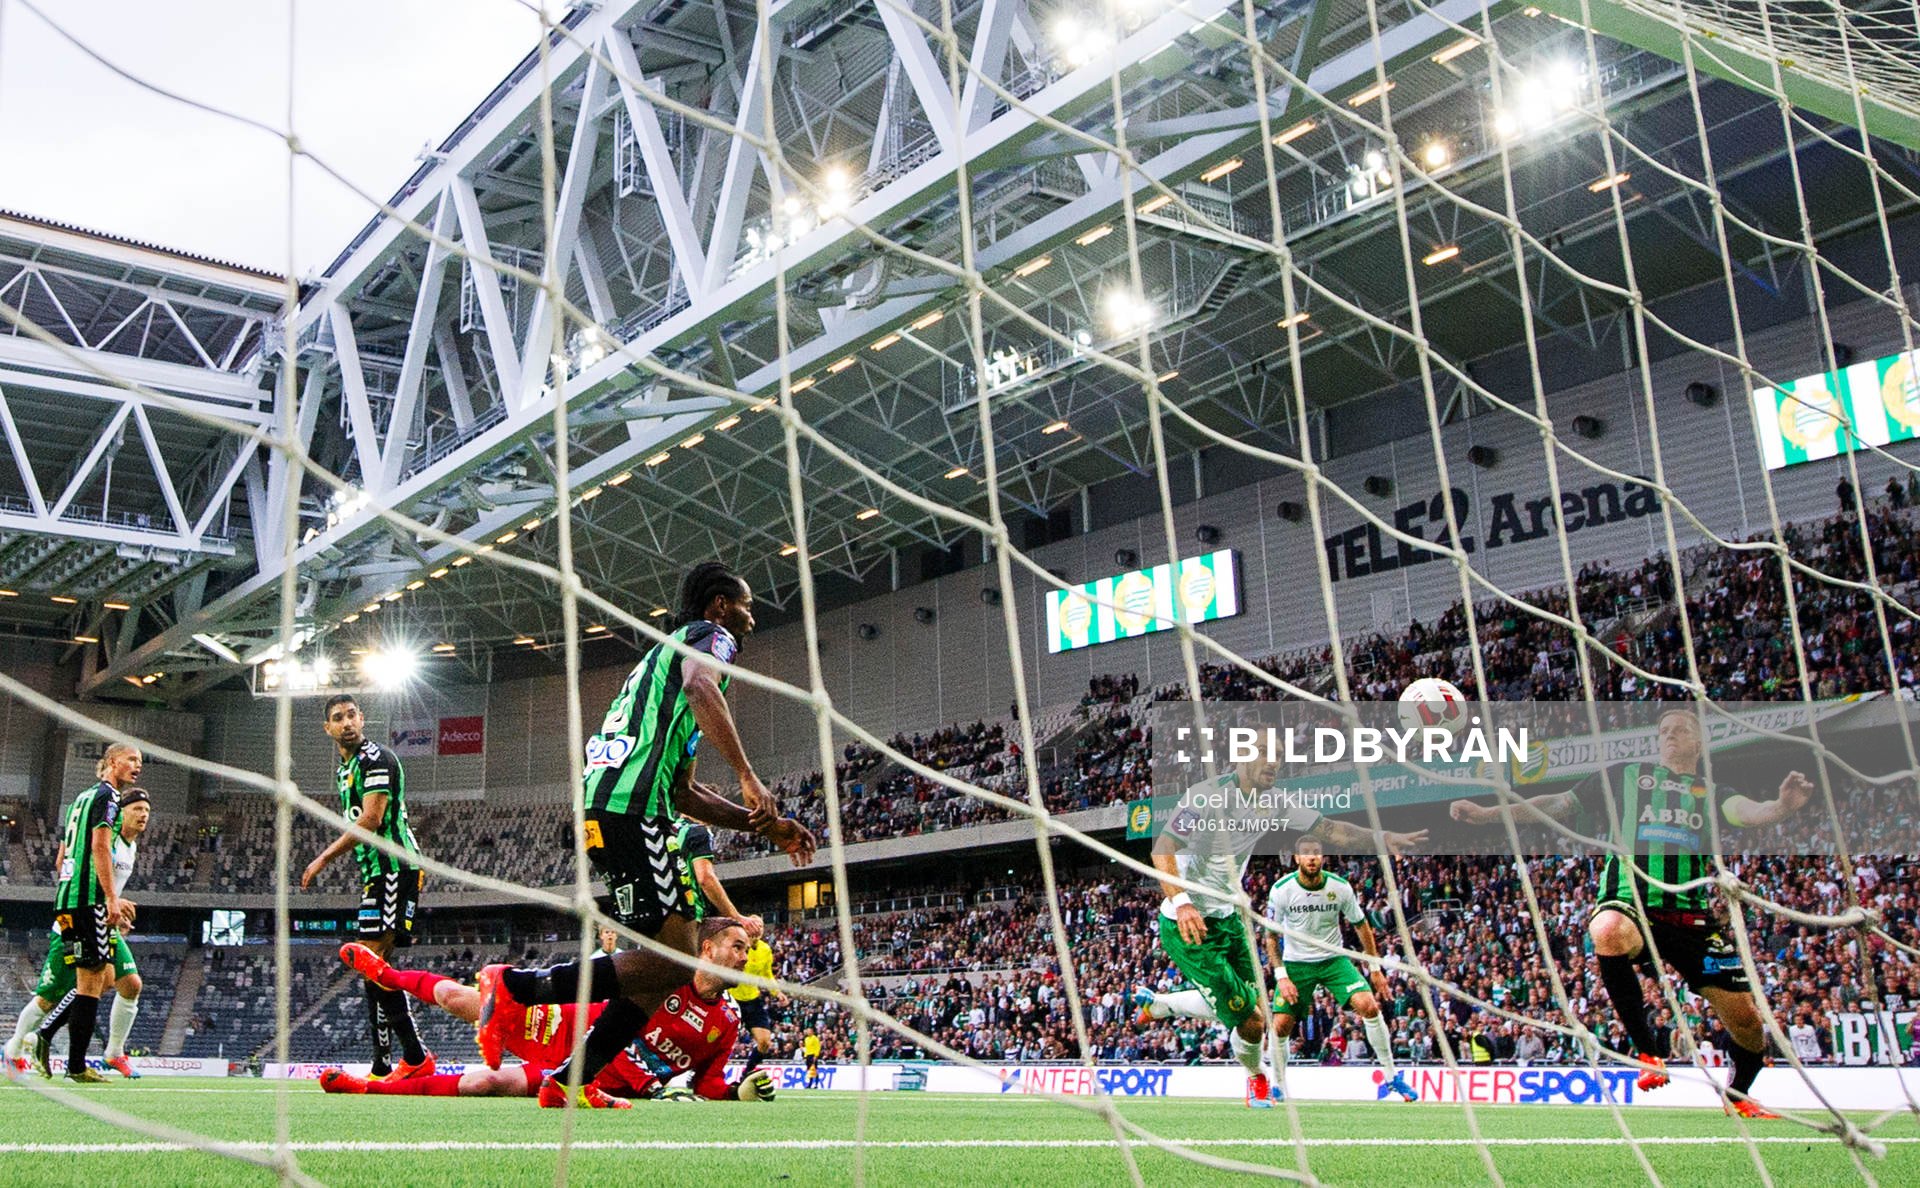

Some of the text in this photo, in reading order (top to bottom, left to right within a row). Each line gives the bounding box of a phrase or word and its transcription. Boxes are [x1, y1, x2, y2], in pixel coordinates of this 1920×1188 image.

[1325, 475, 1661, 582] TELE2 Arena
[442, 731, 480, 741] Adecco
[1289, 902, 1338, 914] HERBALIFE
[1023, 1068, 1163, 1096] INTERSPORT
